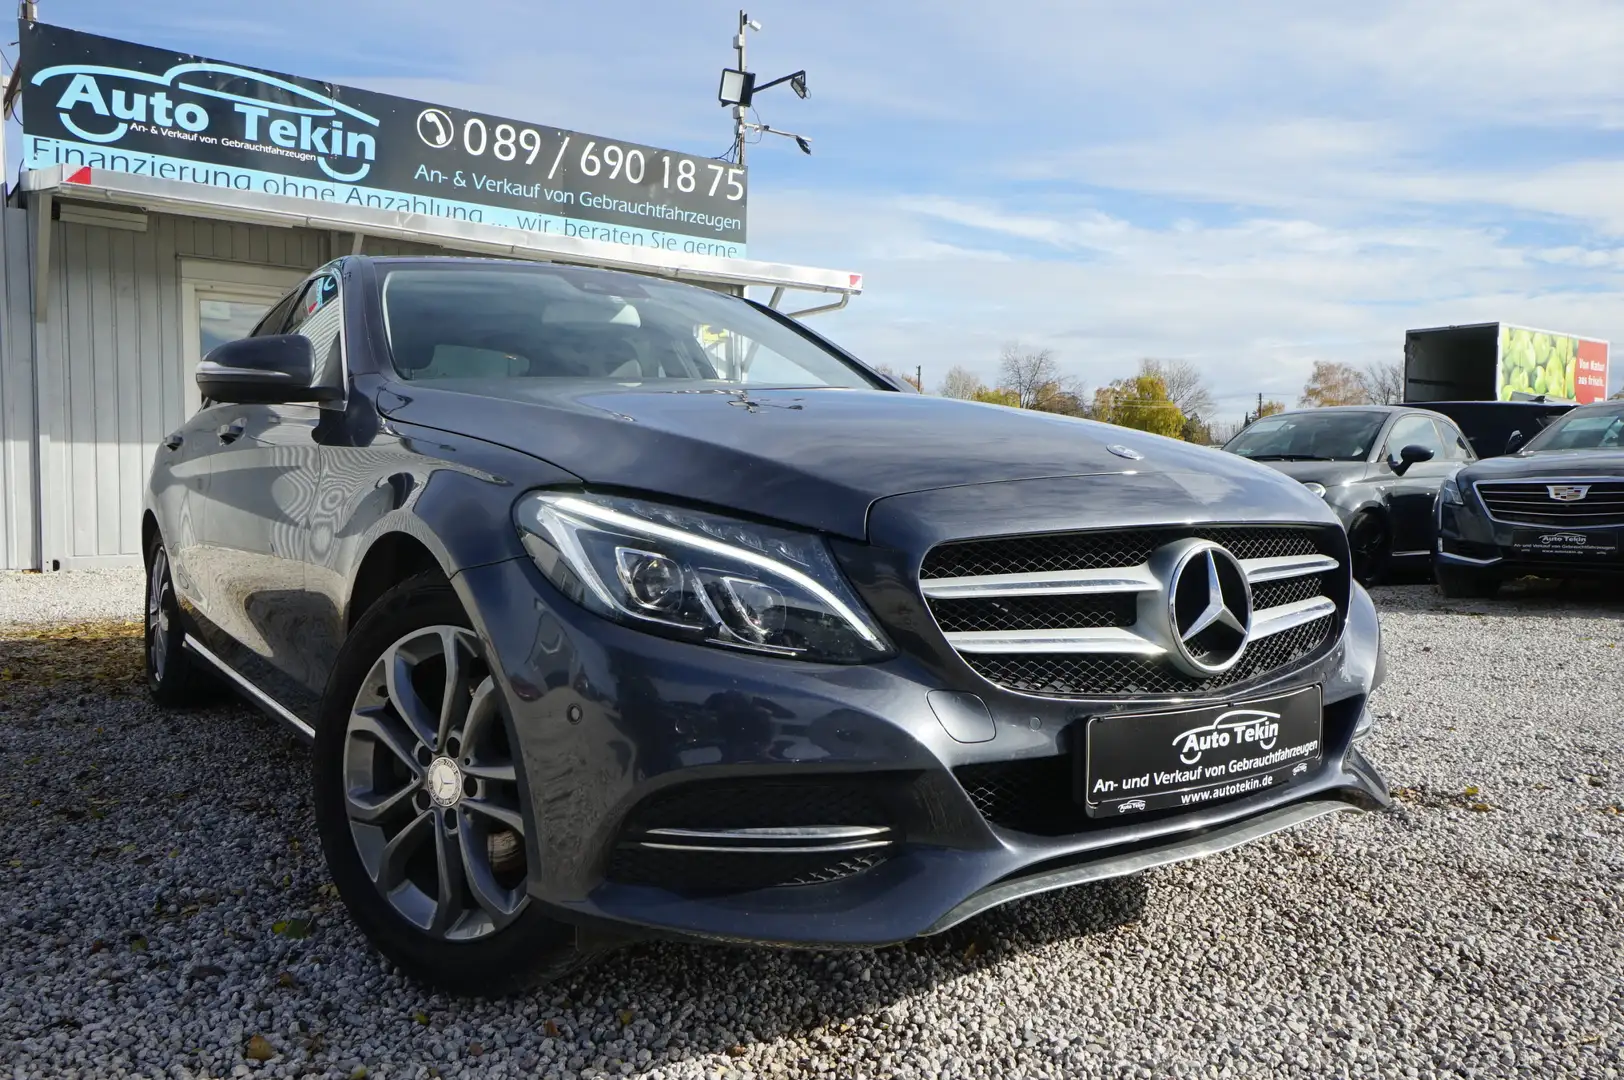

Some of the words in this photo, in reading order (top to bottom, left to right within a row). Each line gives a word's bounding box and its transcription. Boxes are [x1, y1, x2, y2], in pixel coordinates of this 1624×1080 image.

[56, 74, 209, 133] Auto
[234, 103, 375, 161] Tekin
[130, 122, 149, 133] An-
[151, 127, 159, 135] &
[161, 128, 198, 142] Verkauf
[199, 135, 218, 145] von
[221, 138, 316, 161] Gebrauchtfahrzeugen
[463, 118, 541, 165] 089
[547, 137, 570, 180] /
[580, 141, 645, 185] 690
[661, 156, 697, 193] 18
[707, 163, 745, 201] 75
[33, 137, 251, 191] Finanzierung
[263, 177, 335, 201] ohne
[345, 187, 483, 223] Anzahlung
[517, 214, 551, 232] wir
[564, 218, 644, 247] beraten
[651, 231, 677, 250] Sie
[683, 240, 738, 260] gerne
[414, 164, 448, 183] An-
[453, 170, 467, 188] &
[472, 173, 541, 199] Verkauf
[543, 188, 574, 204] von
[579, 191, 742, 231] Gebrauchtfahrzeugen
[1093, 778, 1118, 793] An-
[1122, 773, 1149, 790] und
[1153, 765, 1203, 786] Verkauf
[1204, 763, 1225, 778] von
[1228, 740, 1318, 774] Gebrauchtfahrzeugen
[1182, 731, 1230, 753] Auto
[1234, 721, 1279, 744] Tekin
[1181, 775, 1273, 805] www.autotekin.de
